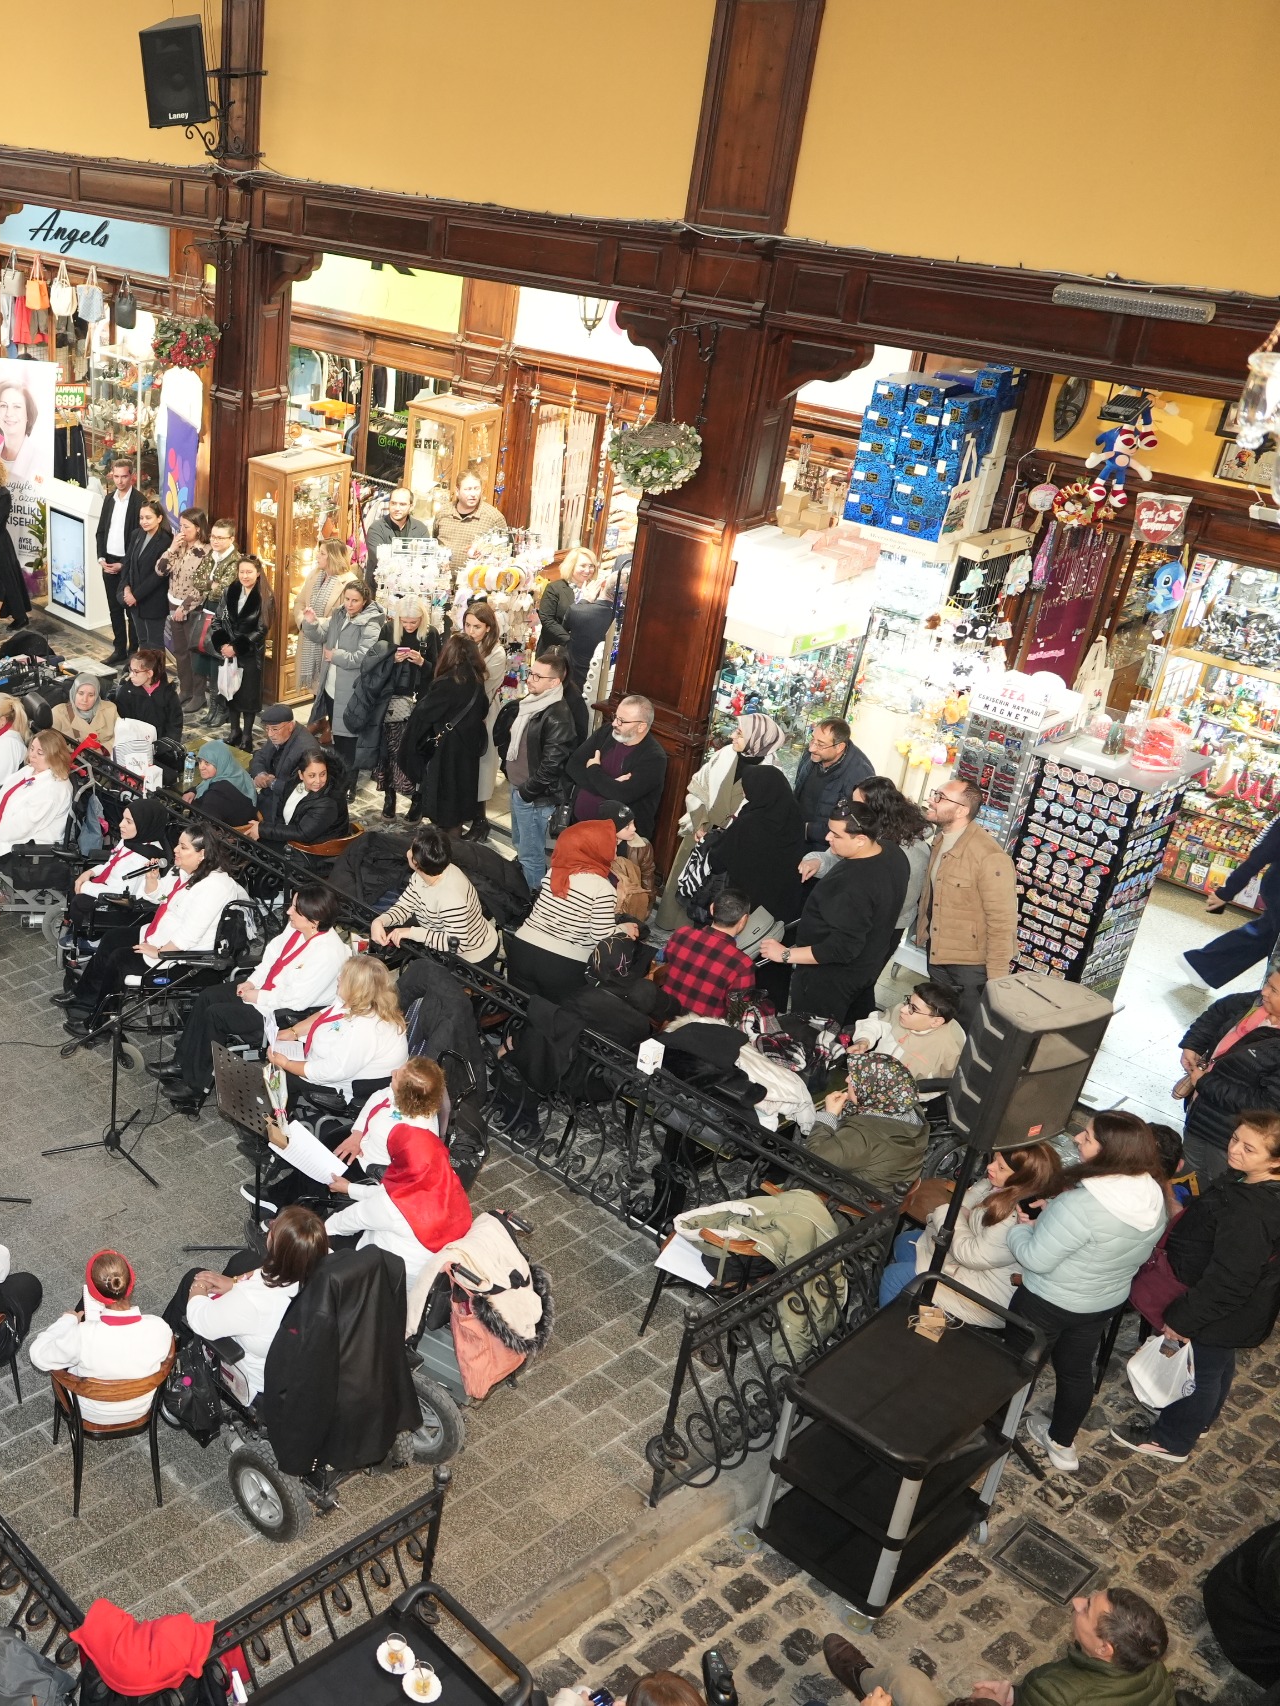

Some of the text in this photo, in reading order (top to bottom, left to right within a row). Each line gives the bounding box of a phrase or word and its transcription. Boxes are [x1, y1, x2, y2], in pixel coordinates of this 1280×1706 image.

[168, 112, 189, 120] Laney
[29, 209, 110, 253] Angels
[56, 386, 84, 394] KAMPANYA
[1001, 687, 1026, 703] ZEA
[984, 703, 1029, 722] MAGNET
